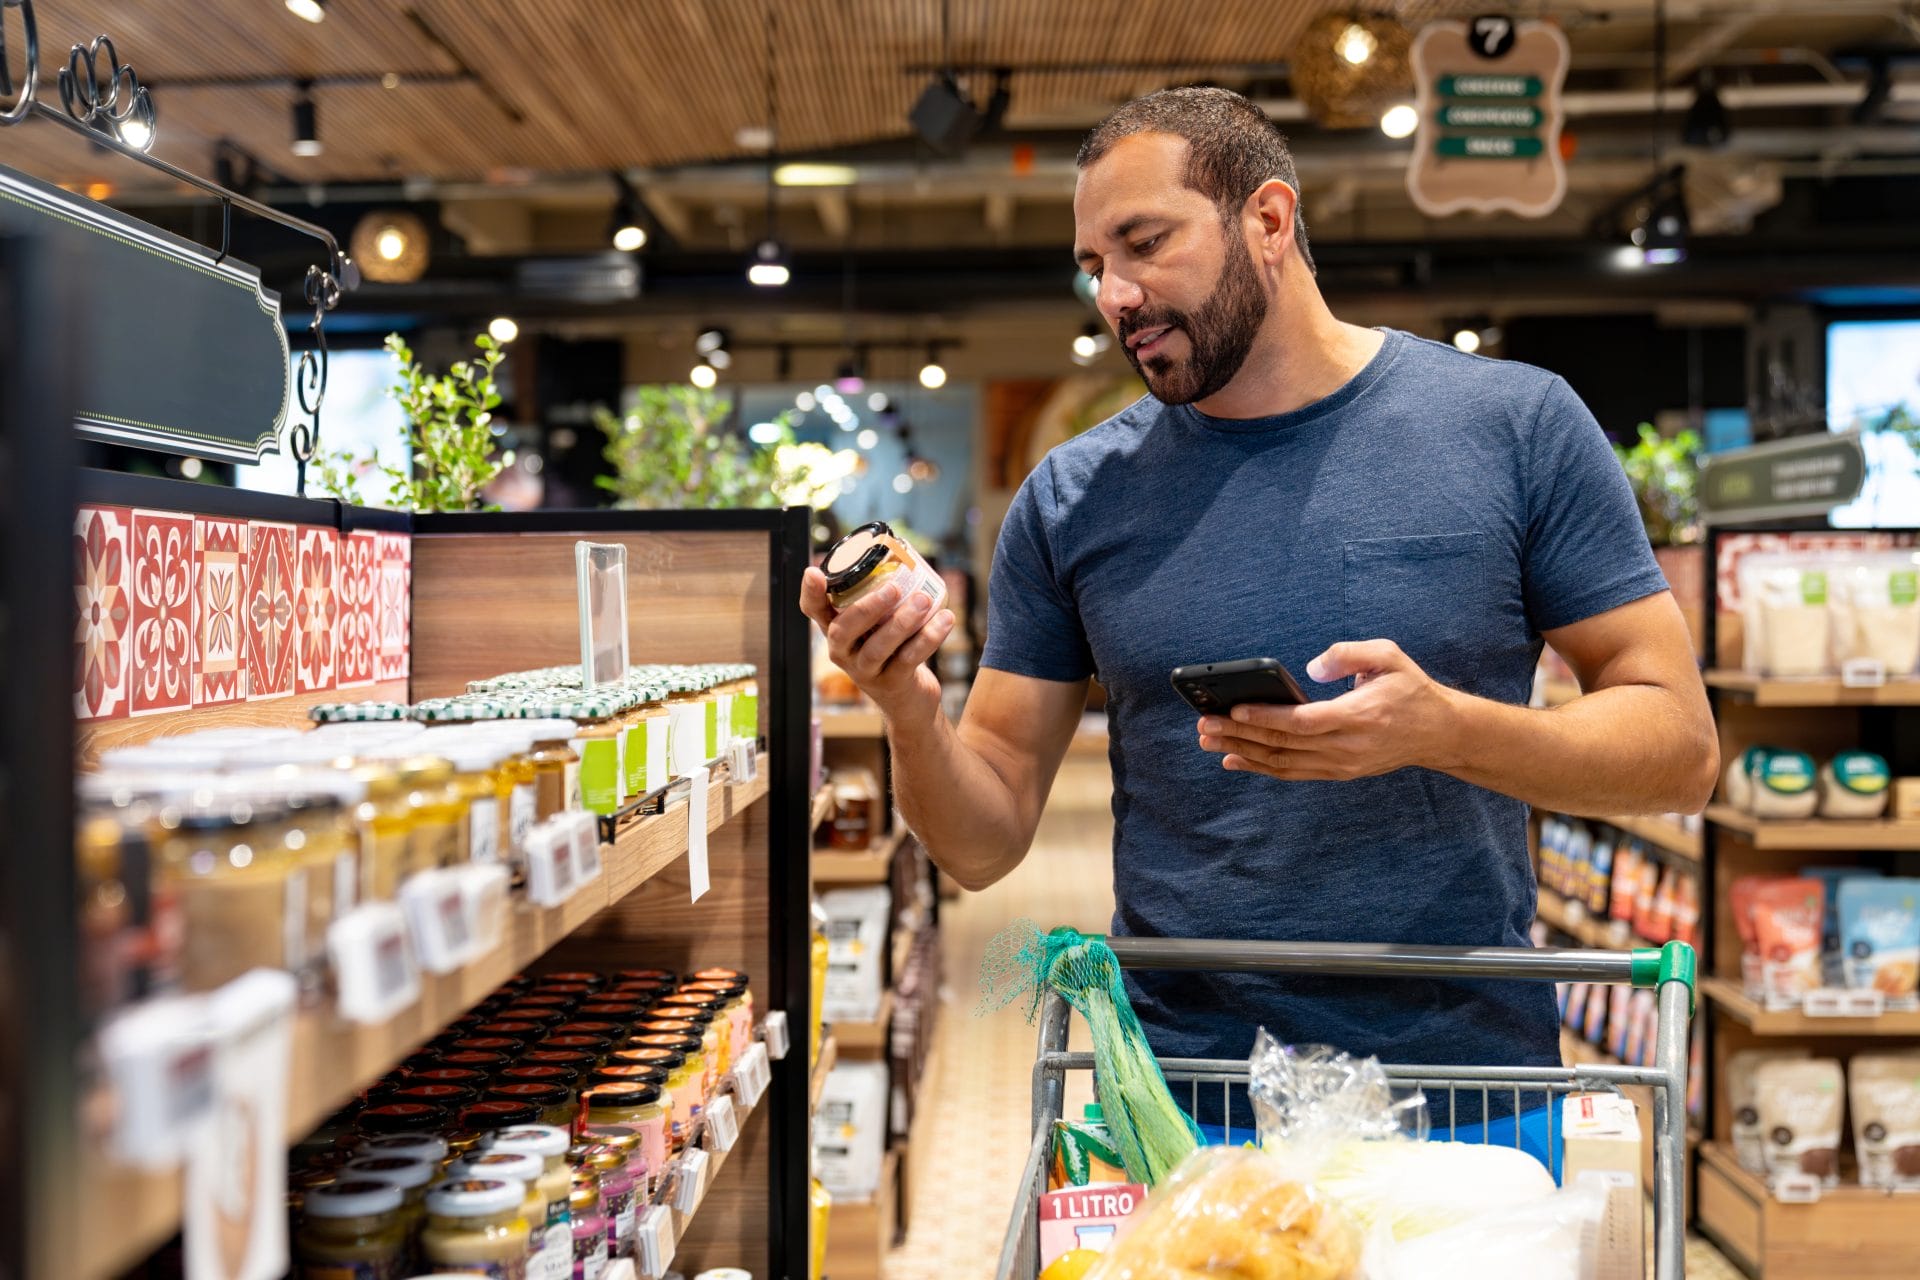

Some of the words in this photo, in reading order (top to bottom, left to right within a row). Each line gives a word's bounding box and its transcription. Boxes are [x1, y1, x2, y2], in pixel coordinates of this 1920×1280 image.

[1475, 18, 1509, 55] 7
[1052, 1197, 1062, 1219] 1
[1068, 1192, 1134, 1218] LITRO
